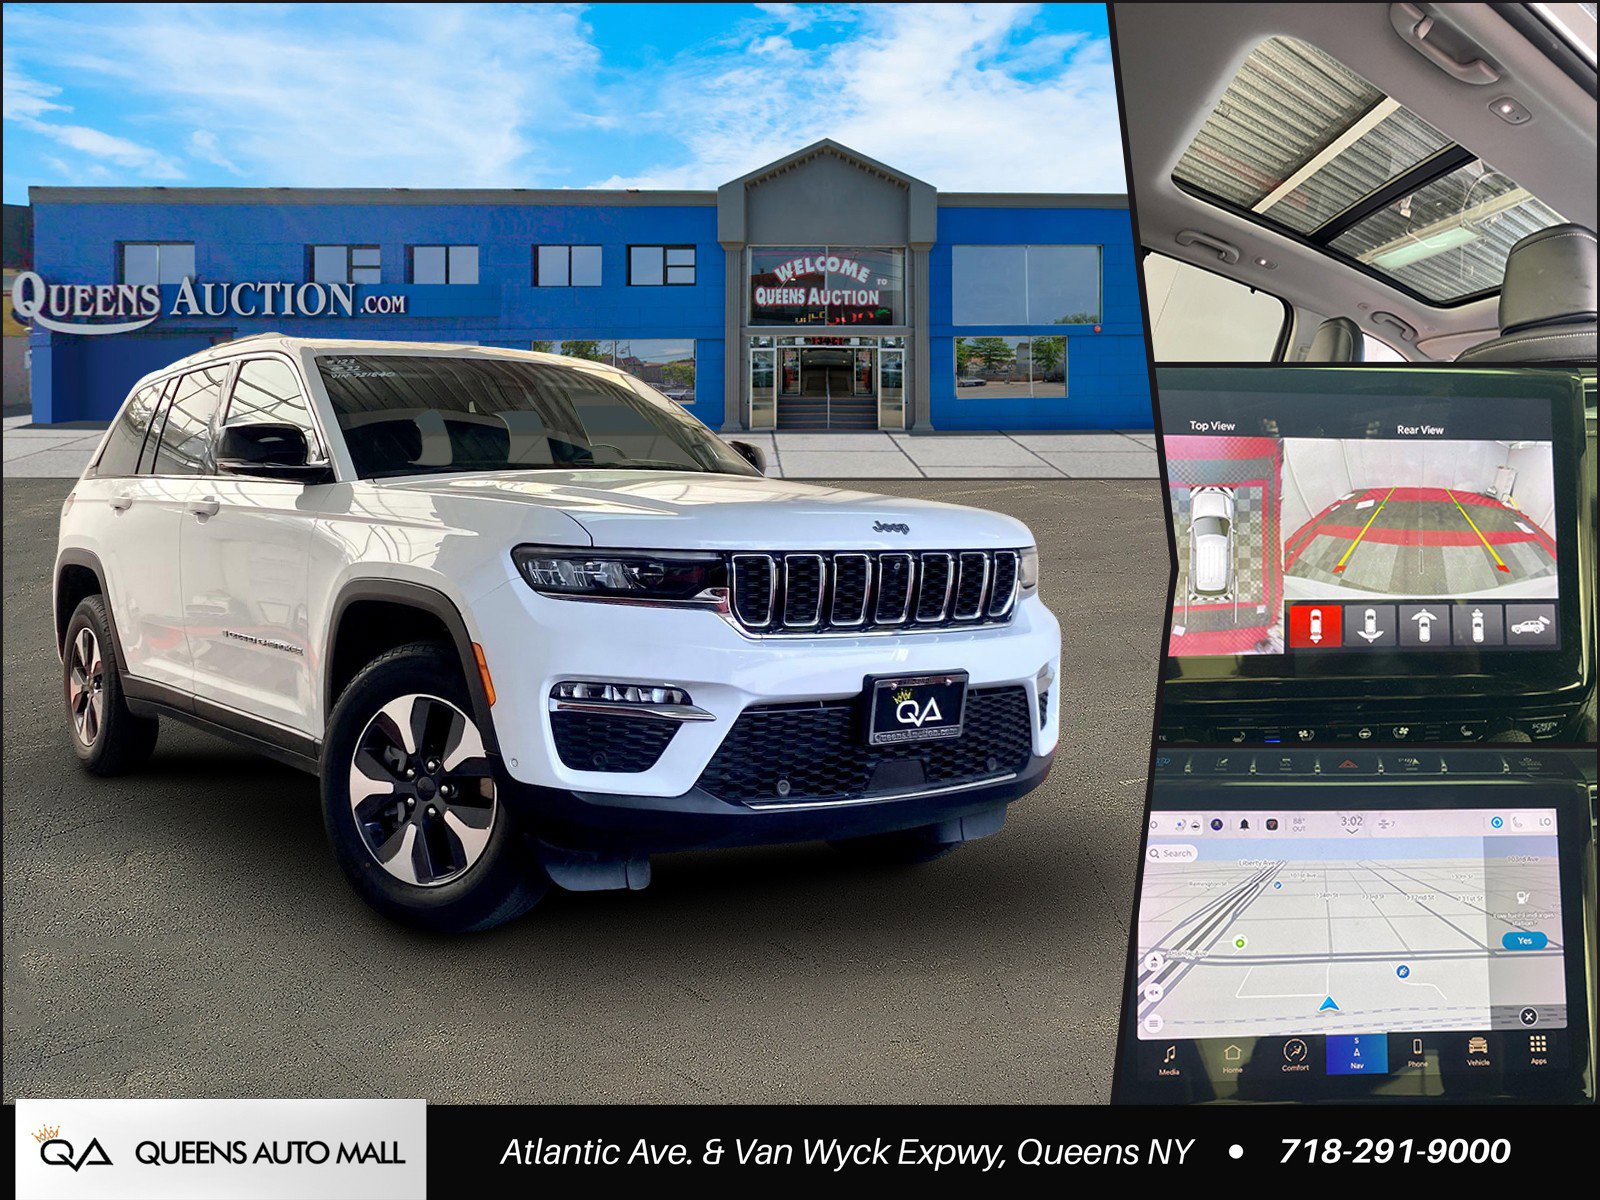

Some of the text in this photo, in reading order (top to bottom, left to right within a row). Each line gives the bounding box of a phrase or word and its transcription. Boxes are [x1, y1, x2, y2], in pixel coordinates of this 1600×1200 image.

[773, 255, 872, 284] WELCOME
[755, 286, 880, 306] QUEENS AUCTION
[12, 270, 160, 335] QUEENS
[1190, 420, 1236, 432] Top View
[1397, 424, 1444, 435] Rear View
[872, 519, 910, 535] Jeep
[896, 696, 943, 728] QA
[1341, 816, 1363, 826] 3:02
[1539, 818, 1552, 827] LO
[1163, 849, 1192, 858] Search
[1239, 860, 1262, 868] Liberty
[1517, 936, 1533, 945] Yes
[1350, 1062, 1364, 1070] Nav
[1408, 1060, 1429, 1068] Phone
[1466, 1059, 1491, 1067] Vehicle
[1531, 1058, 1548, 1066] Apps
[1158, 1068, 1180, 1076] Media
[1281, 1064, 1310, 1072] Comfort
